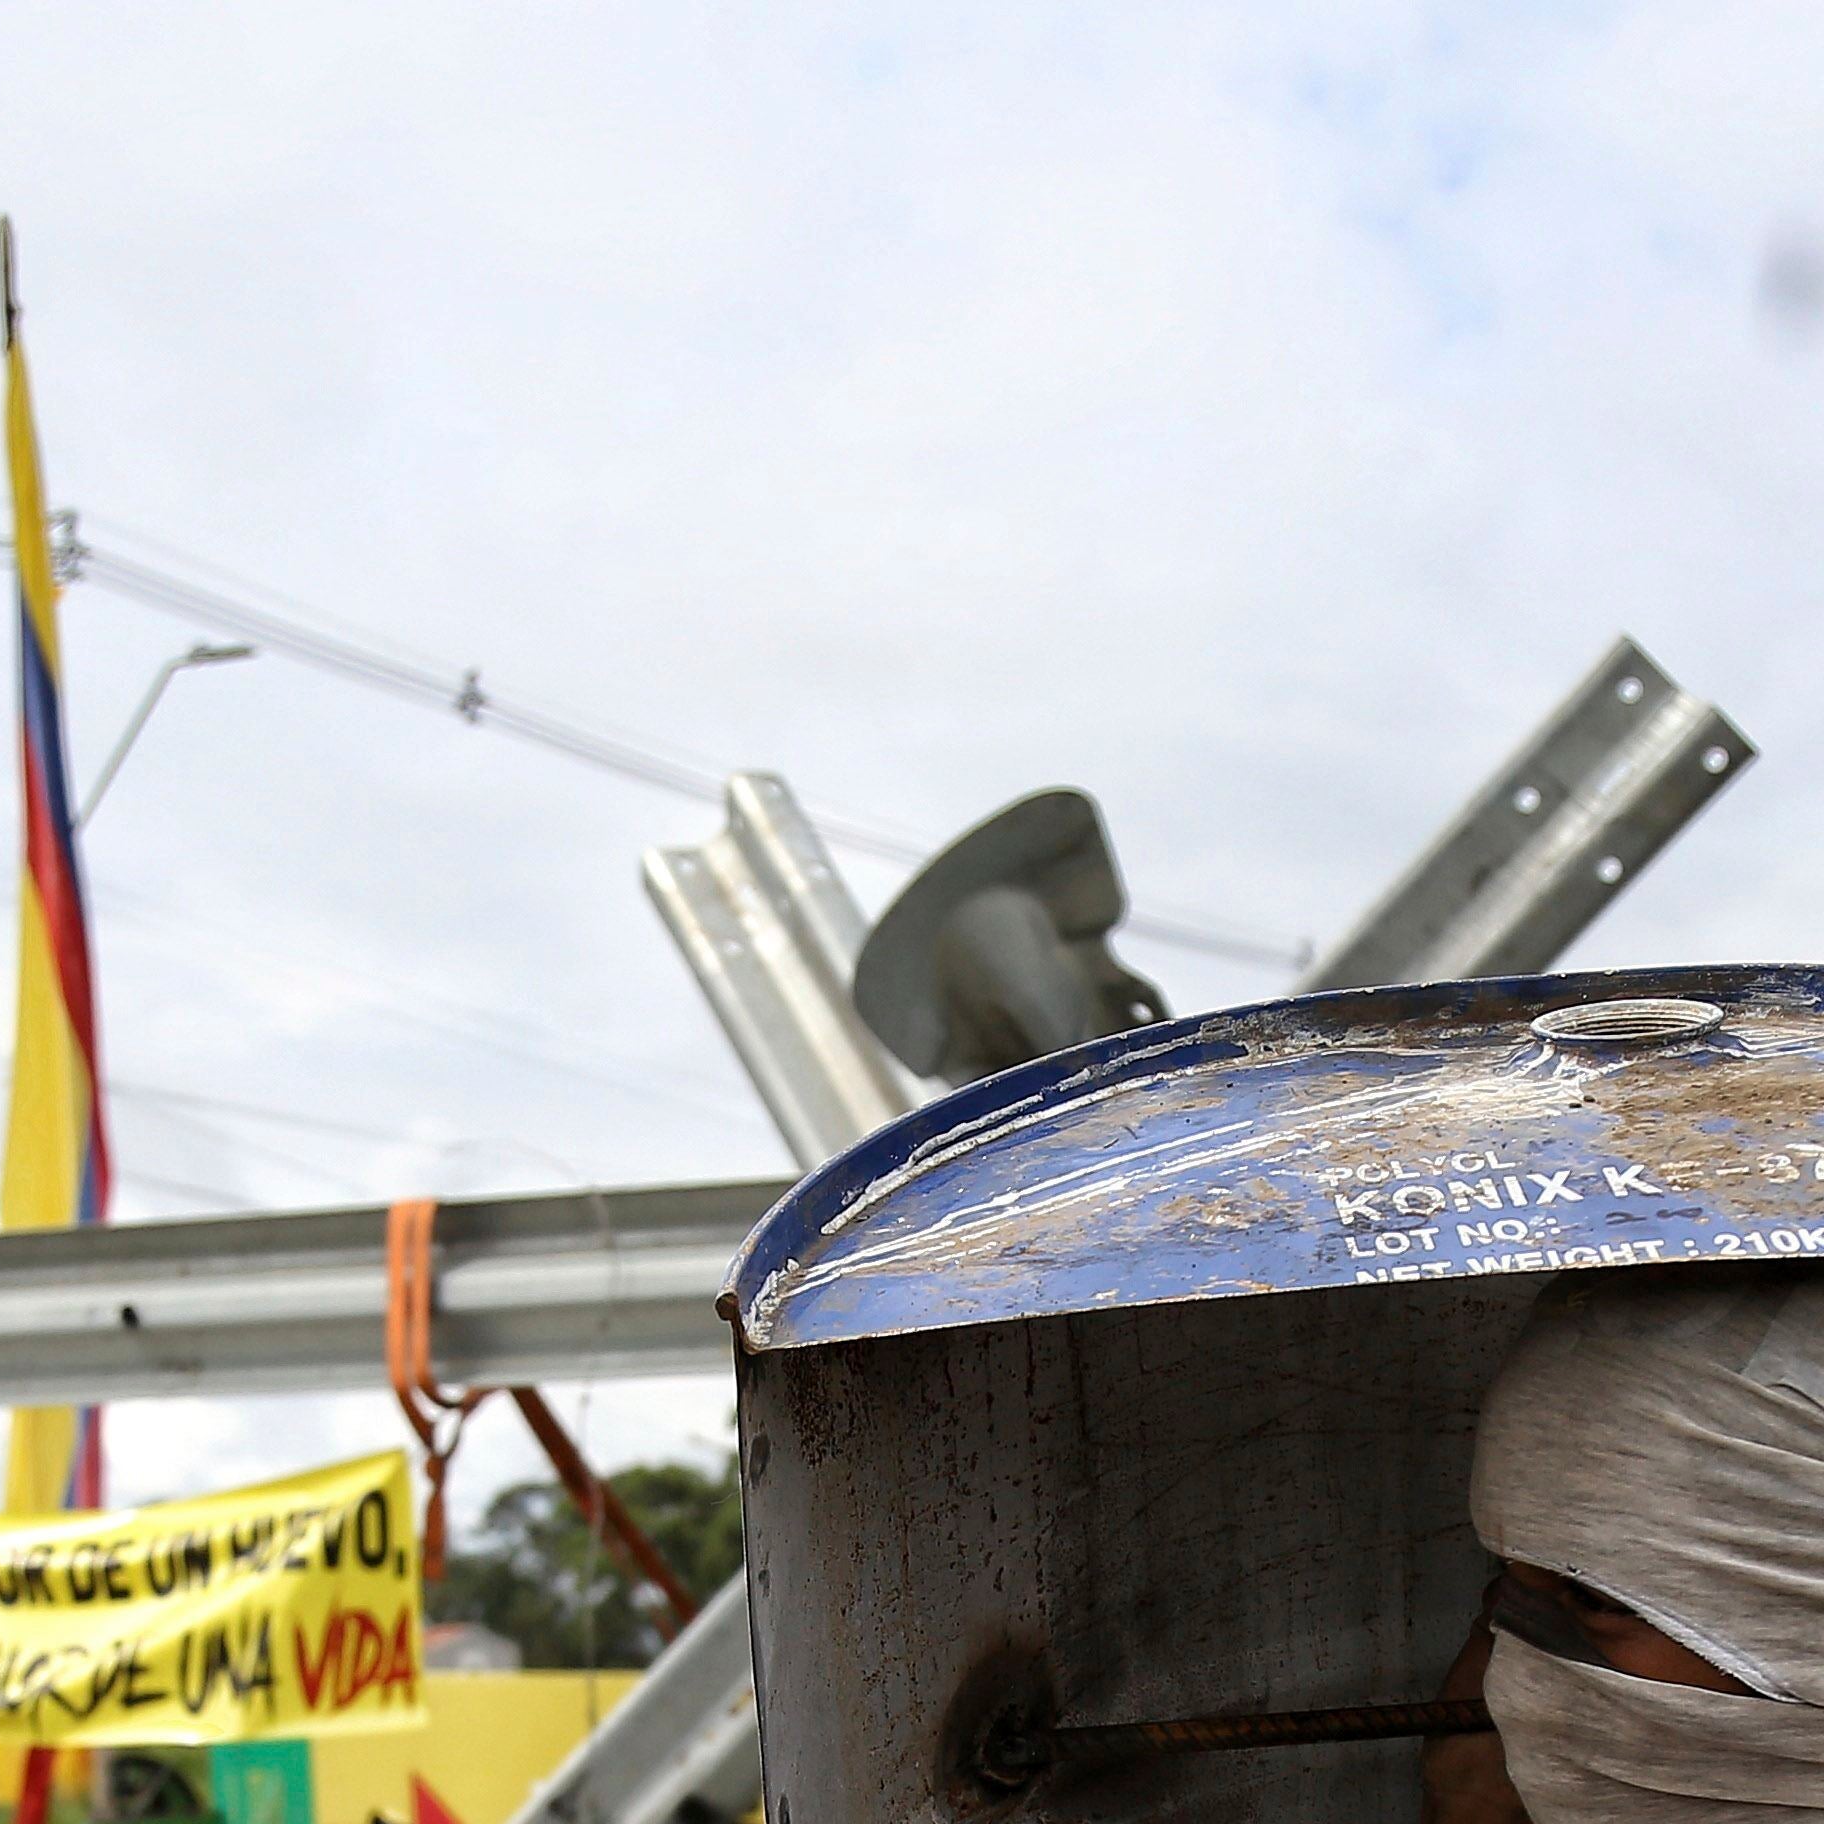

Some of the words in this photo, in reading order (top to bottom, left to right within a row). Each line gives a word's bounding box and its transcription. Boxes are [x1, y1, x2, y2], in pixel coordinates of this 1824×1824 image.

[1335, 1169, 1584, 1225] KONIX
[1345, 1227, 1439, 1258] LOT
[66, 1539, 132, 1602] DE
[146, 1527, 212, 1597] UN
[180, 1610, 275, 1718] UNA
[293, 1605, 418, 1712] VIDA
